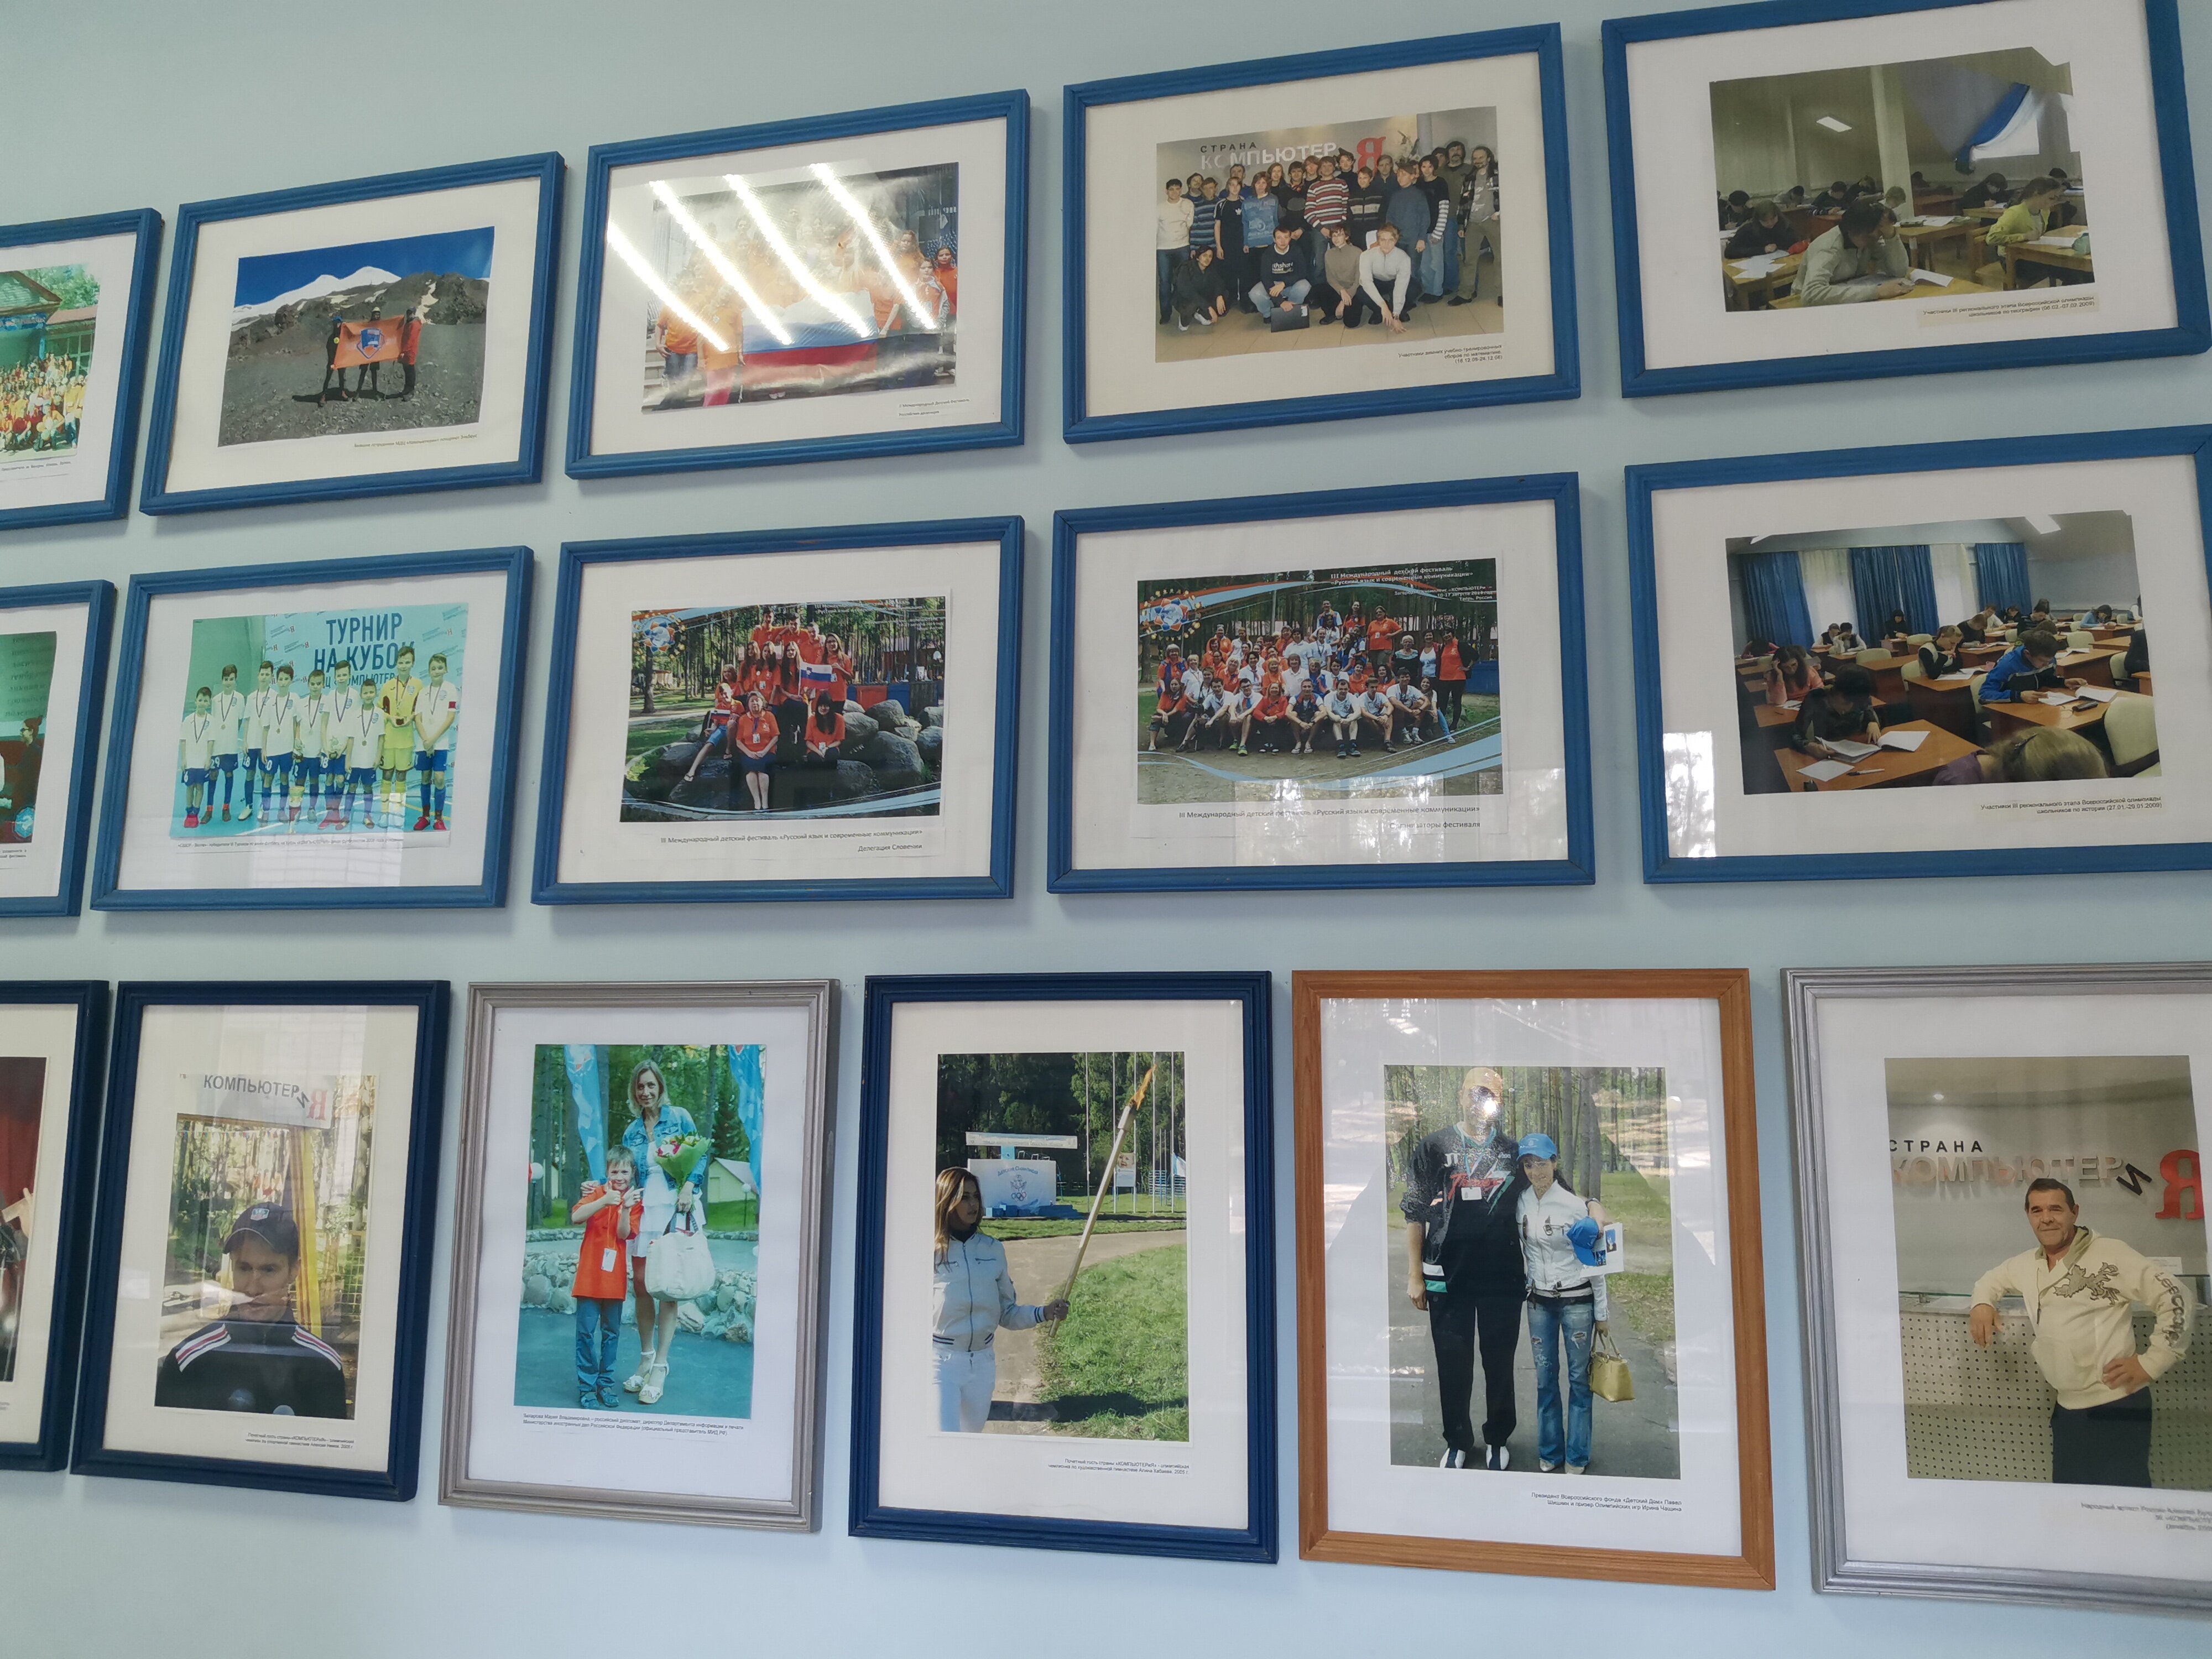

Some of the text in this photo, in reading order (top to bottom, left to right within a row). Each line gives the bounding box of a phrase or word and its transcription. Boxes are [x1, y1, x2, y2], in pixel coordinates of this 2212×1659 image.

[1200, 142, 1256, 153] СТРАНА
[1340, 570, 1391, 580] Международный
[325, 612, 403, 646] ТУРНИР
[314, 648, 338, 674] НА
[346, 640, 415, 671] КУБО
[1443, 821, 1481, 830] фестиваля
[1889, 1140, 1984, 1153] СТРАНА
[1561, 1494, 1603, 1503] Всероссийского
